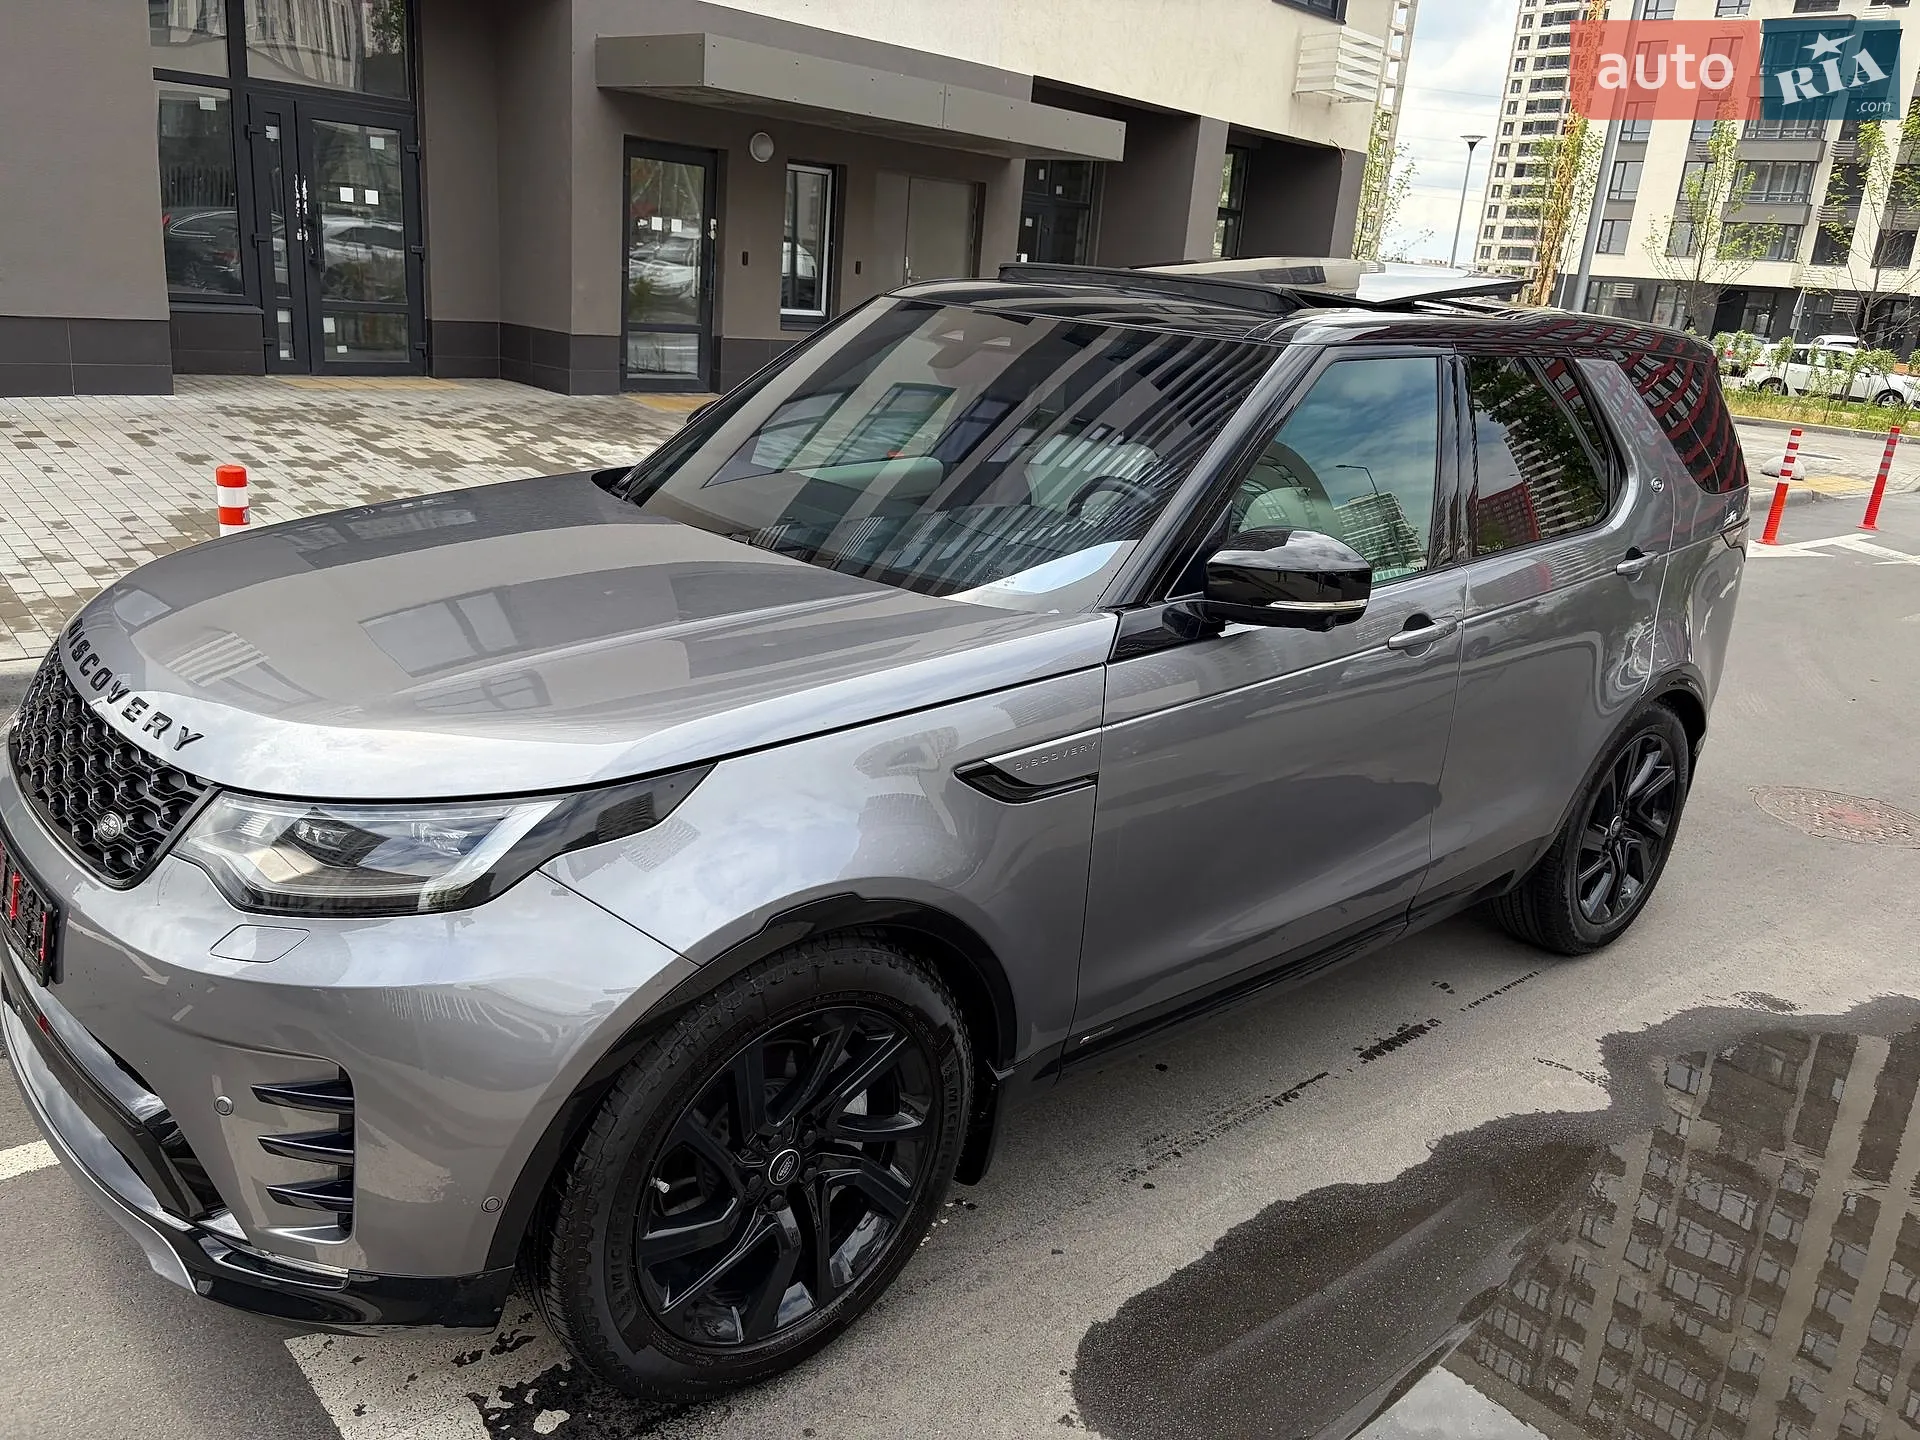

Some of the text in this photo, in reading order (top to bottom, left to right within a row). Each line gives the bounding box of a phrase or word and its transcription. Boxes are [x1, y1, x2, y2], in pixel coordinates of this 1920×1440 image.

[67, 617, 205, 752] DISCOVERY
[935, 1086, 958, 1185] MICHELI
[610, 1175, 633, 1291] MICHE
